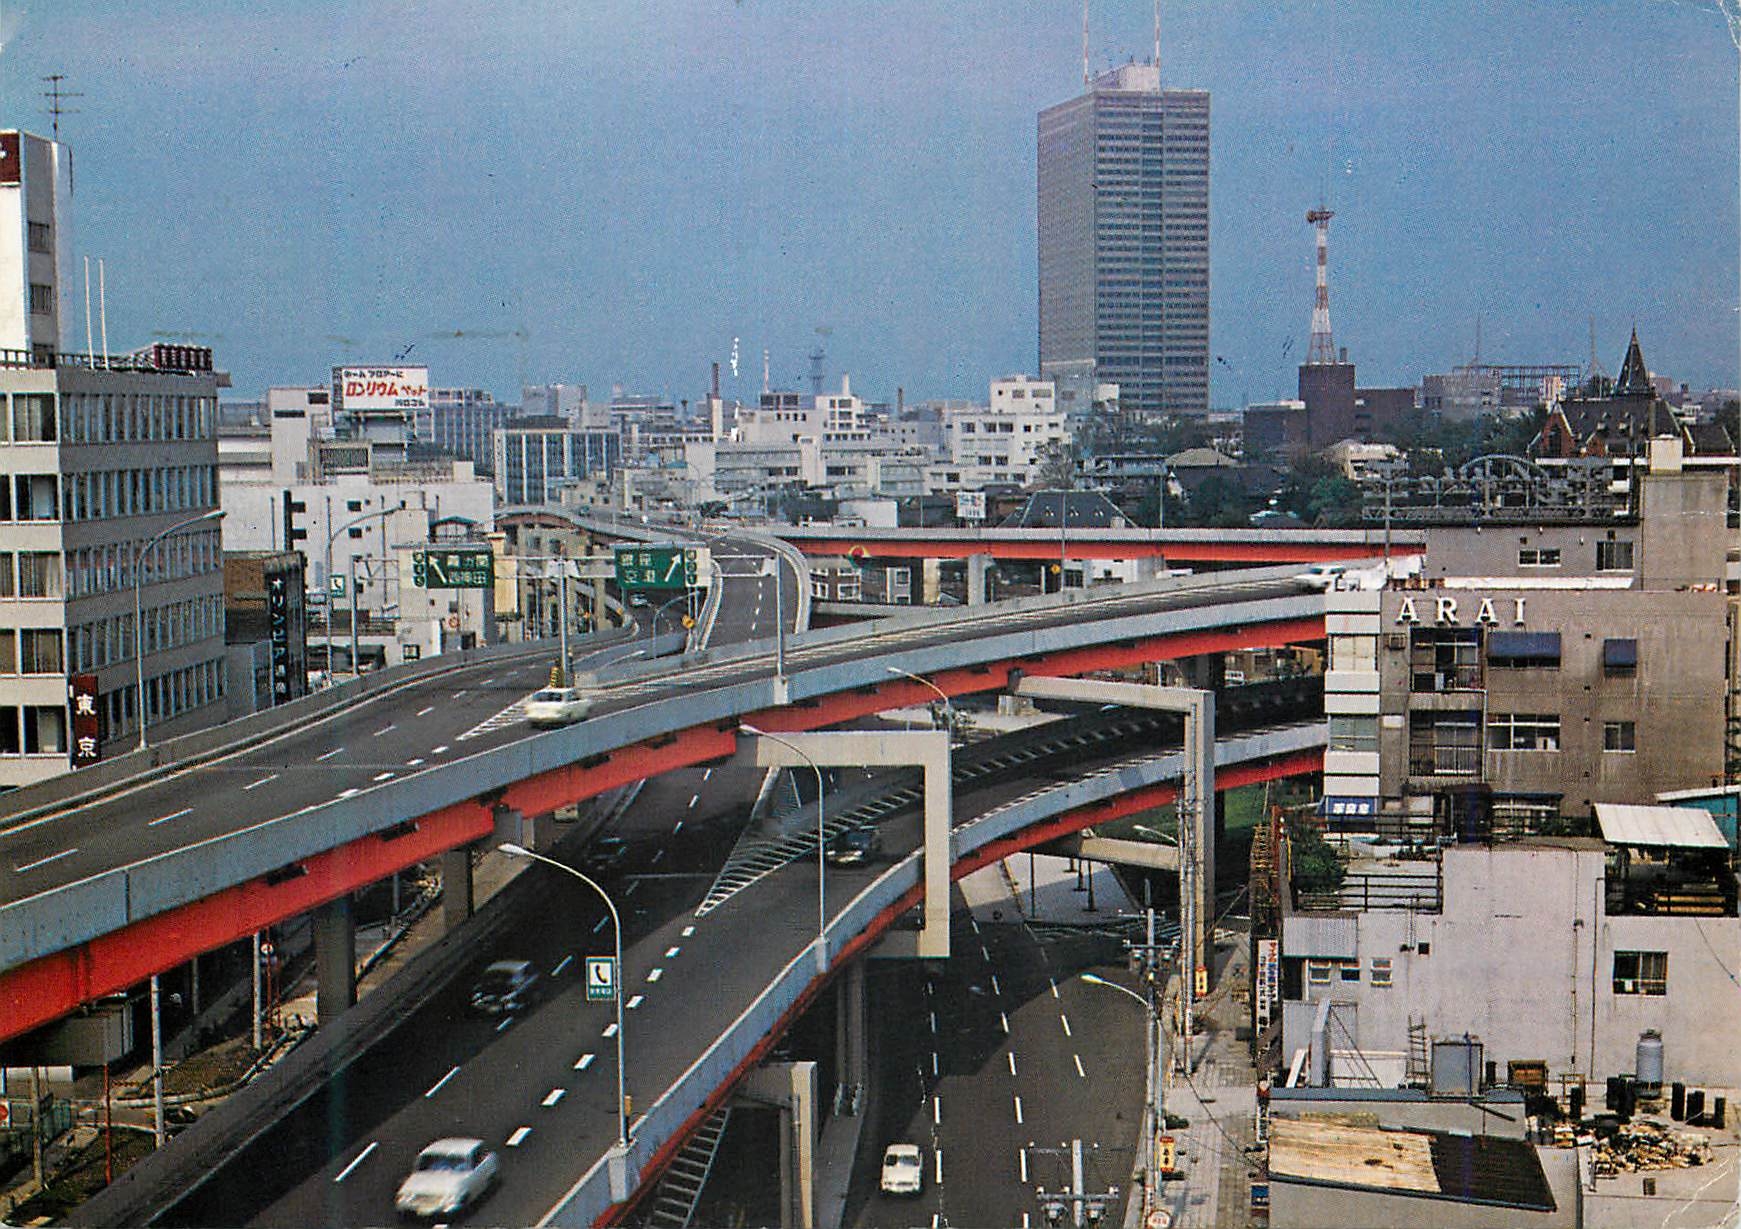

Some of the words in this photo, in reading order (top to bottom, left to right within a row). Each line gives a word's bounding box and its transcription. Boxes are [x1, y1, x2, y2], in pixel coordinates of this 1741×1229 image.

[345, 381, 398, 397] ロンリウム
[1395, 596, 1526, 626] ARAI
[76, 693, 97, 758] 東京
